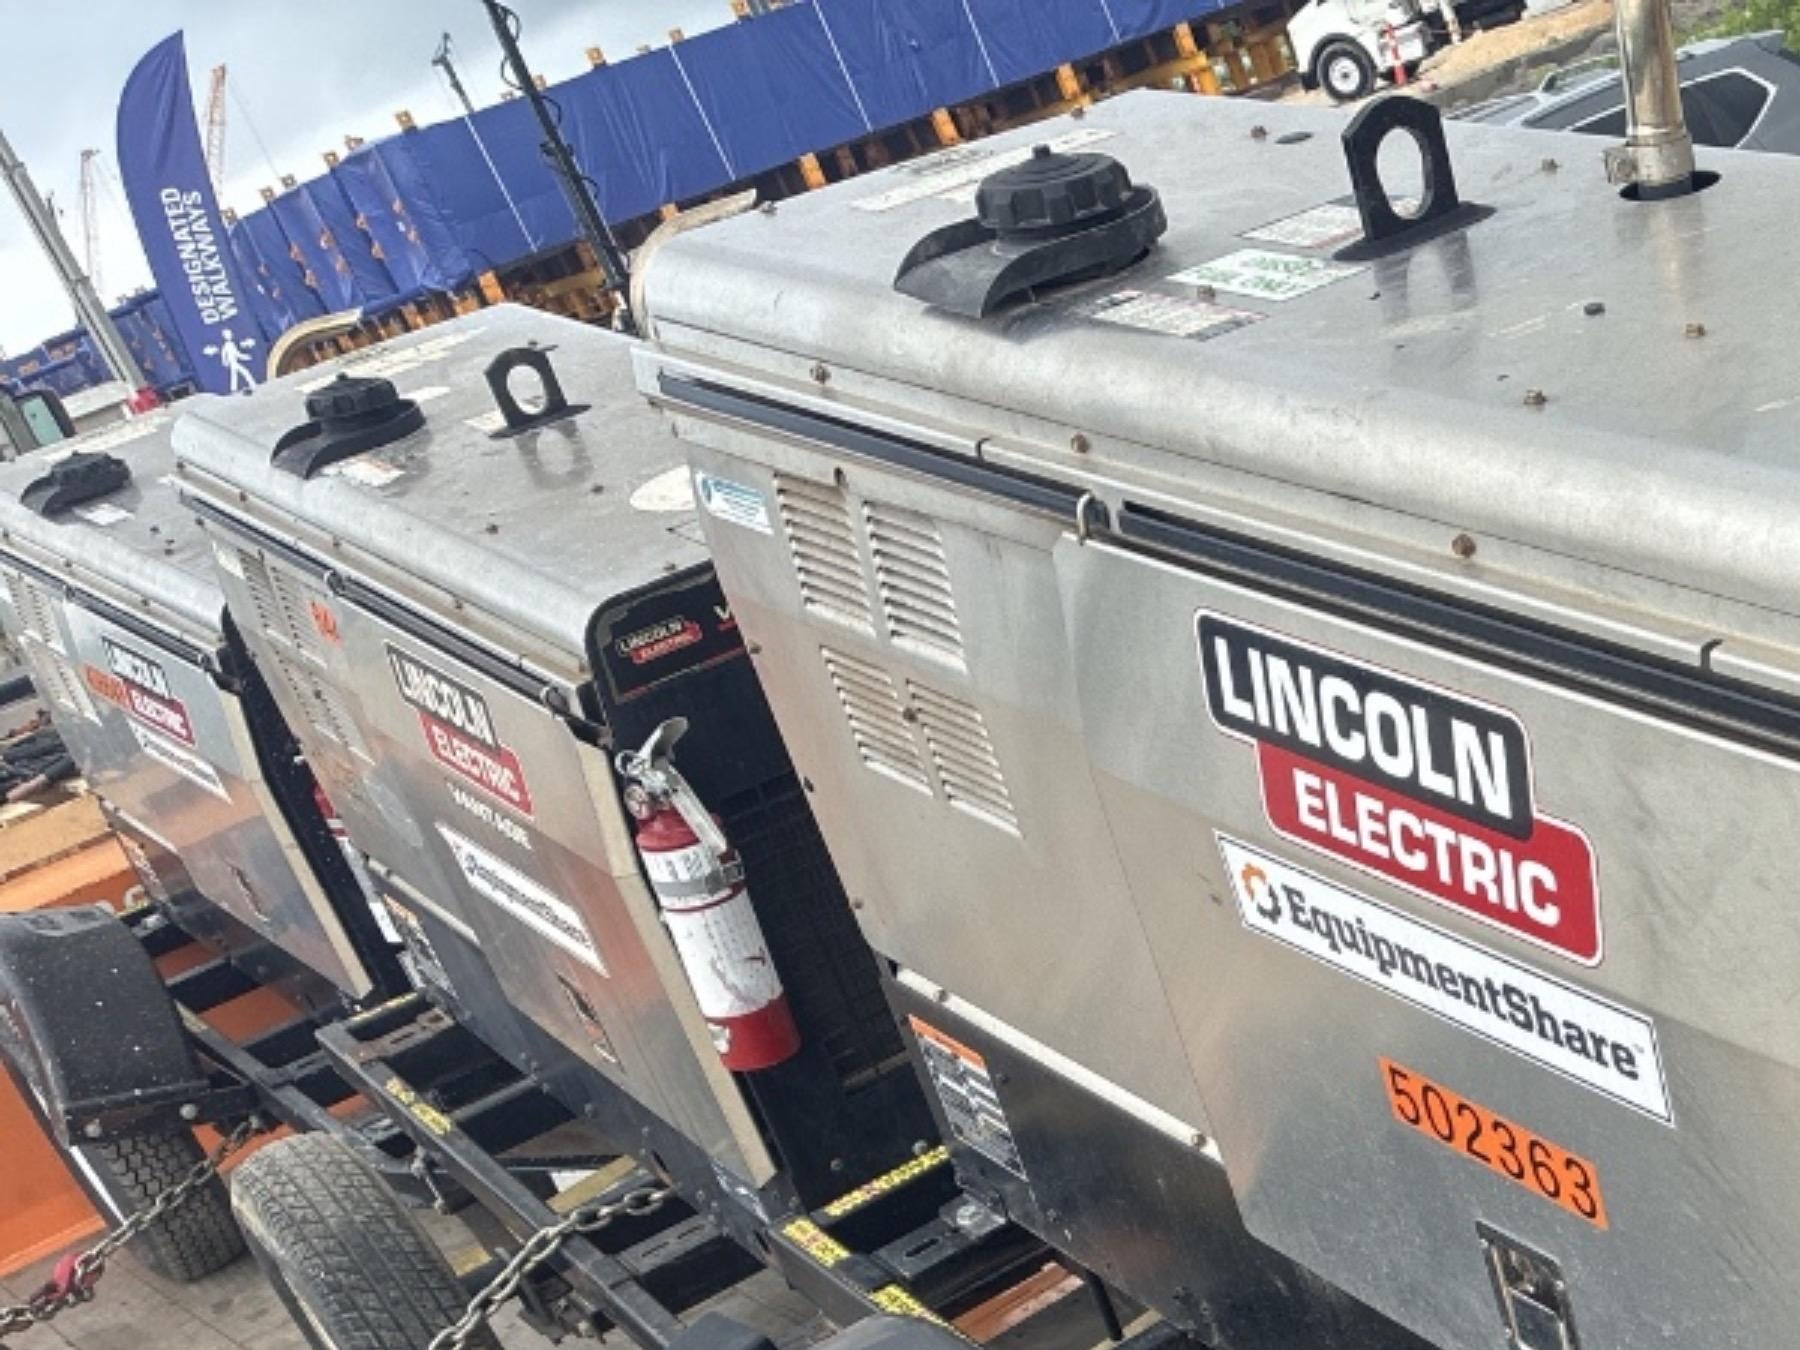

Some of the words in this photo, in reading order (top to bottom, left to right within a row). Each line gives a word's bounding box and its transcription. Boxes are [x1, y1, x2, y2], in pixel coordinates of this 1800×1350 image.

[160, 187, 220, 324] DESIGNATED
[183, 190, 239, 322] WALKWAYS
[1214, 636, 1513, 818] LINCOLN
[1291, 767, 1561, 927] ELECTRIC
[1281, 884, 1639, 1081] EquipmentShare
[1388, 1066, 1599, 1219] 502363
